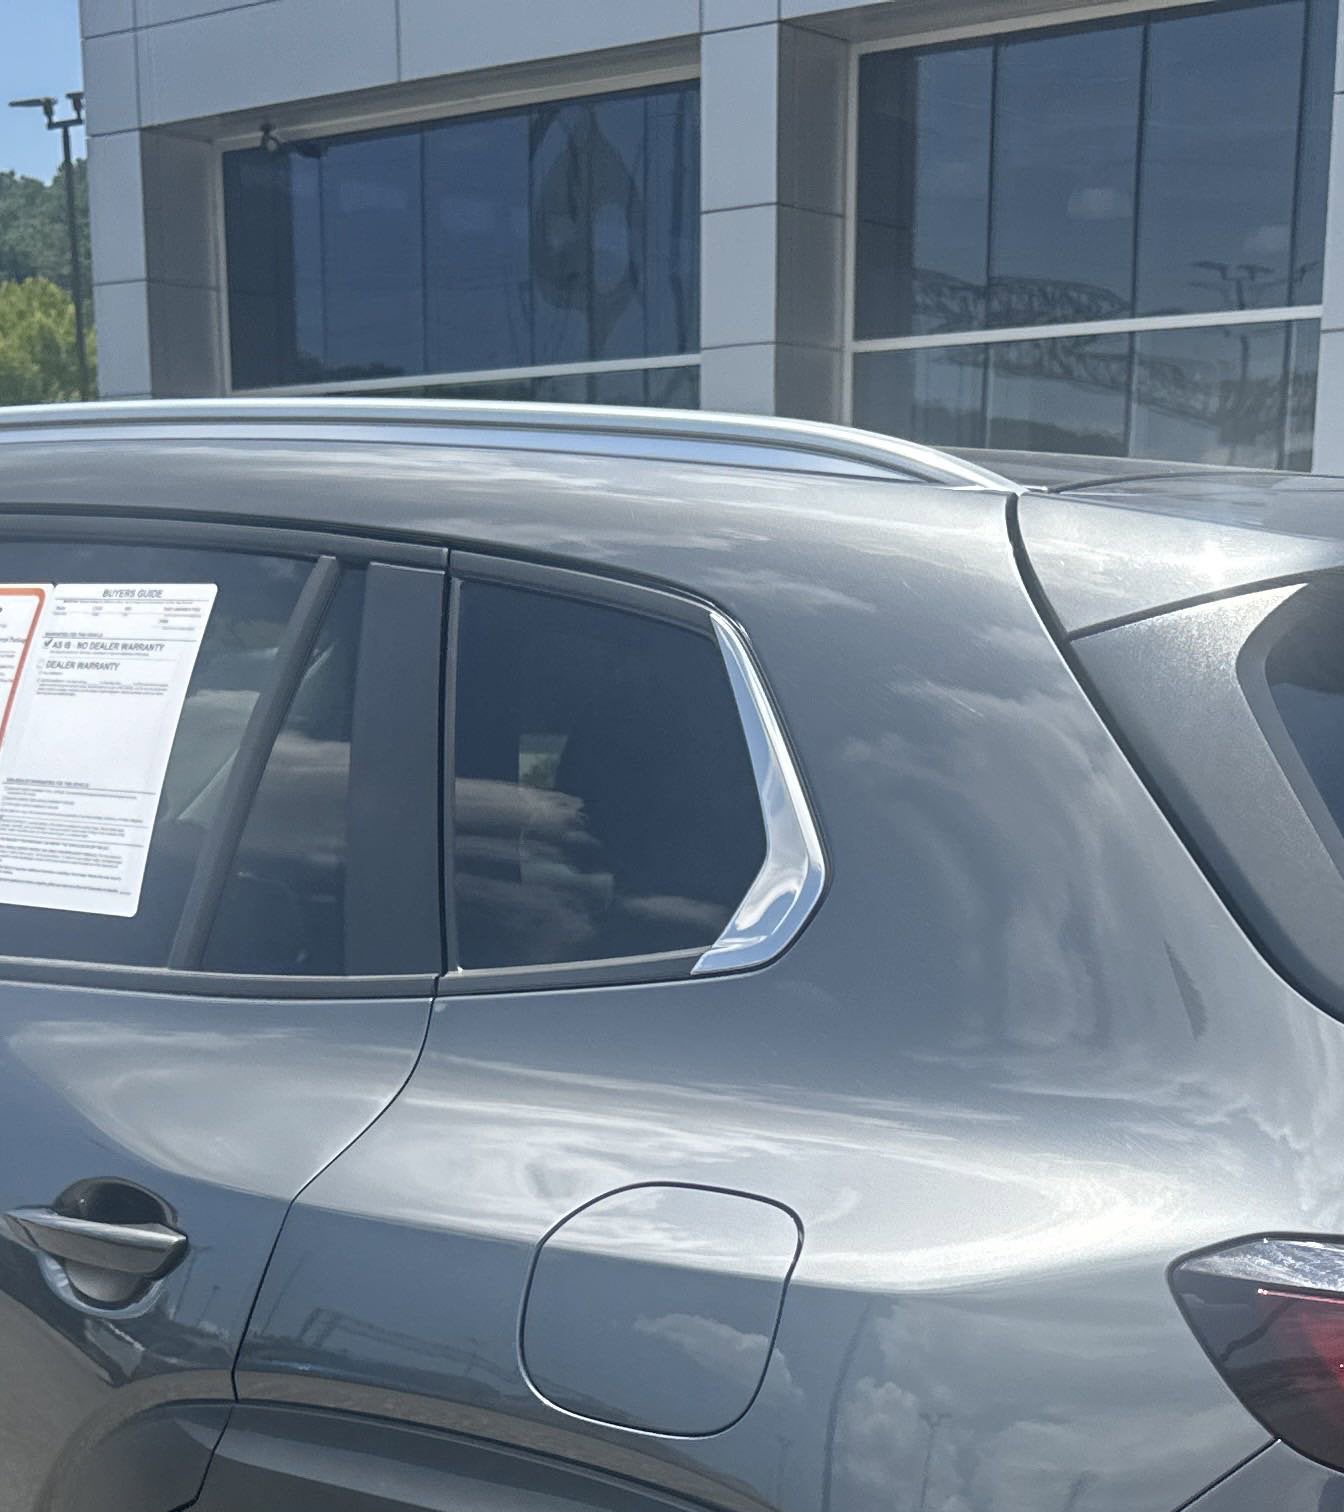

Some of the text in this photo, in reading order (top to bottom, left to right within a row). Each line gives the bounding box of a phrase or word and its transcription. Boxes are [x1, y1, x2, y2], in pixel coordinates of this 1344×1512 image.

[102, 589, 163, 598] BUYERS GUIDE
[52, 641, 62, 649] AS
[64, 641, 71, 649] IS
[77, 641, 88, 650] NO
[89, 641, 119, 651] DEALER
[121, 642, 165, 652] WARRANTY
[46, 661, 120, 671] DEALER WARRANTY
